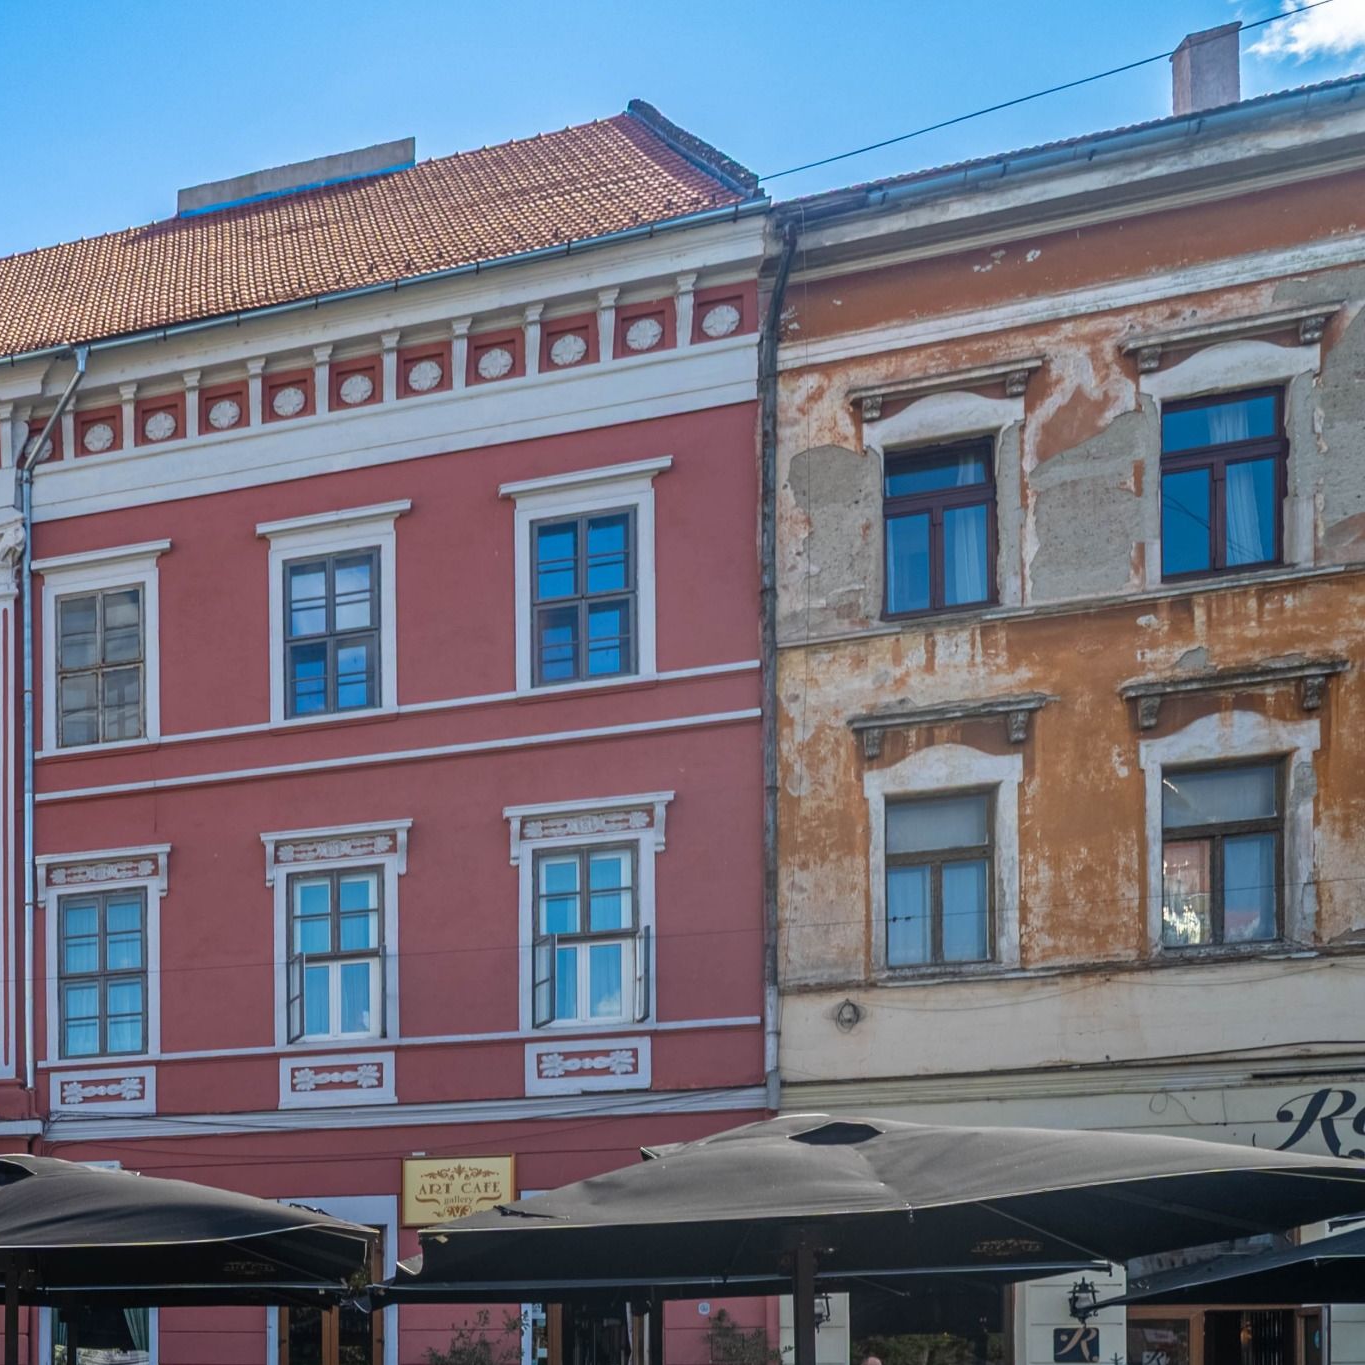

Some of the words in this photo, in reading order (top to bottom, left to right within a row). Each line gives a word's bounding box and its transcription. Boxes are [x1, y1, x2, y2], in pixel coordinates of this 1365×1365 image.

[419, 1183, 452, 1195] ART
[461, 1181, 500, 1194] CAFE
[444, 1196, 474, 1204] gallery
